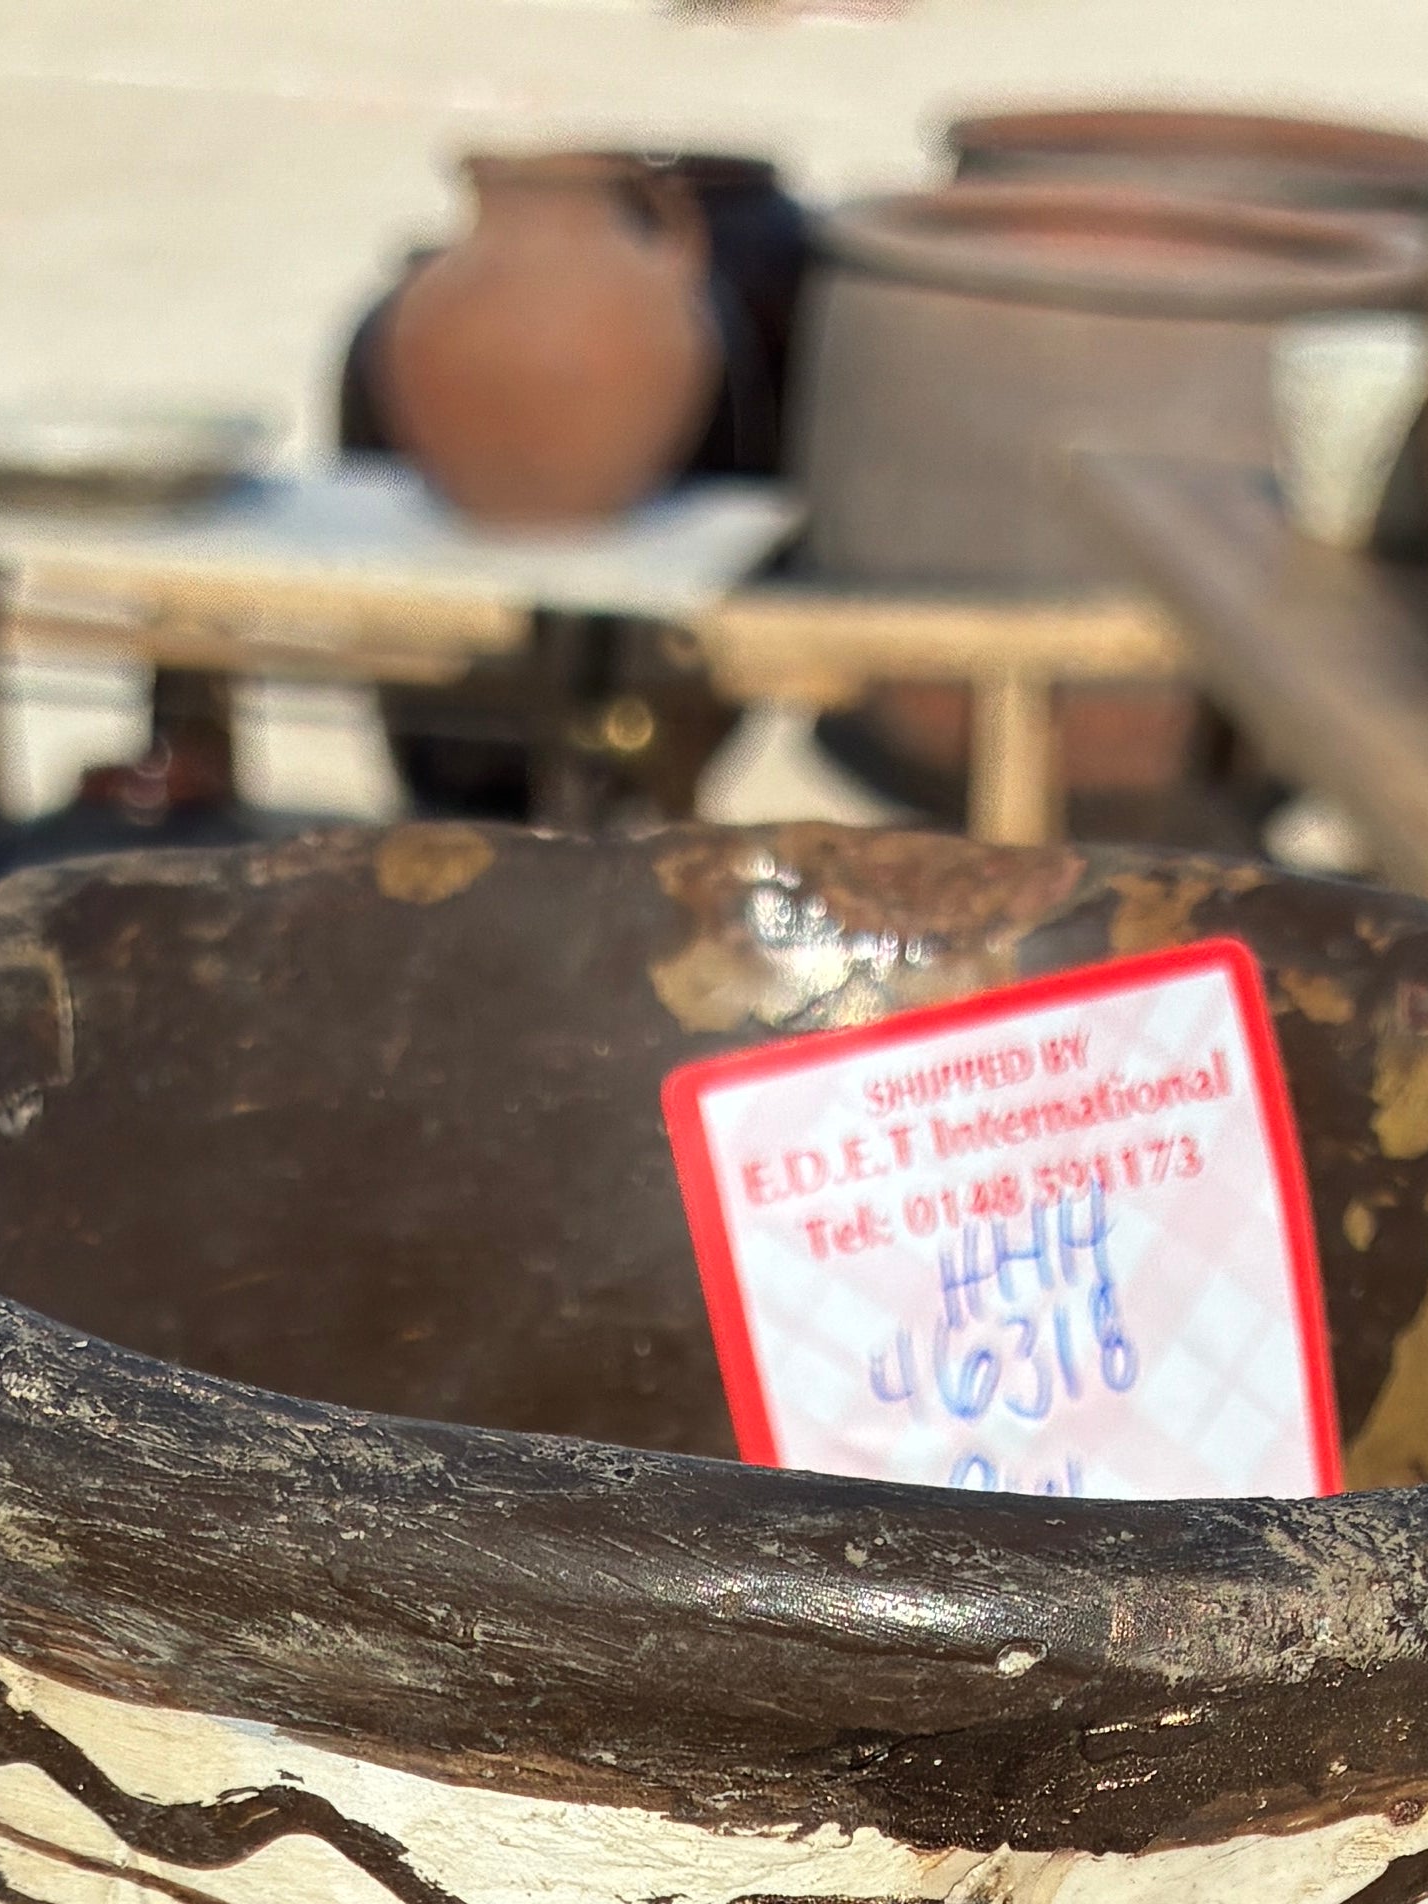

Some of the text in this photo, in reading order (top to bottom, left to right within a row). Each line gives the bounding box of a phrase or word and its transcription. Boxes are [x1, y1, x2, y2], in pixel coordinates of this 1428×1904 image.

[865, 1030, 1090, 1119] SHIPPED BY
[929, 1048, 1231, 1161] International
[804, 1205, 894, 1261] Tel:
